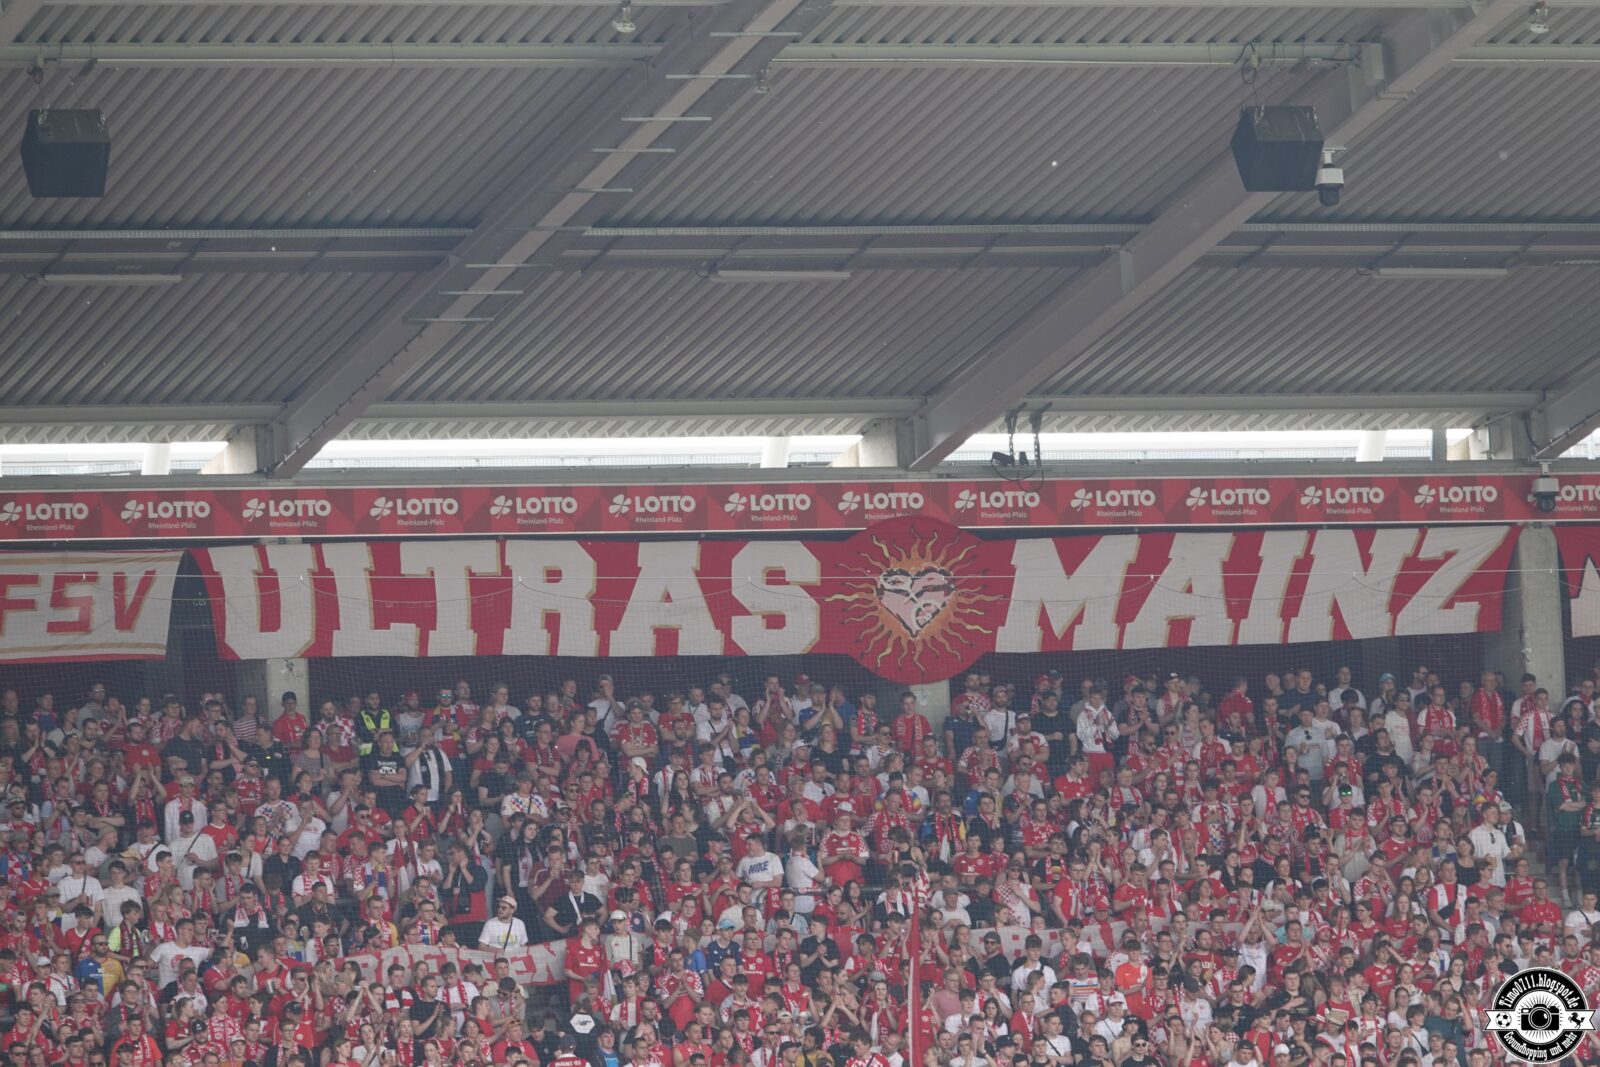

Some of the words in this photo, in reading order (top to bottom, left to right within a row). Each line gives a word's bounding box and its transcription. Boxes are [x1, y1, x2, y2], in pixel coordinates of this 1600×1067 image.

[863, 492, 925, 510] LOTTO
[980, 490, 1041, 508] LOTTO
[1095, 489, 1156, 507] LOTTO
[1211, 488, 1271, 506] LOTTO
[1325, 486, 1385, 505] LOTTO
[1438, 485, 1499, 503] LOTTO
[1555, 484, 1600, 502] OTT
[26, 502, 89, 520] LOTTO
[147, 500, 211, 519] LOTTO
[268, 499, 332, 517] LOTTO
[396, 497, 459, 516] LOTTO
[515, 496, 578, 514] LOTTO
[634, 495, 697, 513] LOTTO
[749, 493, 812, 512] LOTTO
[1438, 506, 1486, 515] Rheinland-Pfalz
[516, 517, 565, 526] Rheinland-Pfalz
[634, 516, 684, 525] Rheinland-Pfalz
[750, 515, 799, 524] Rheinland-Pfalz
[980, 511, 1029, 520] Rheinland-Pfalz
[1096, 510, 1144, 519] Rheinland-Pfalz
[1211, 509, 1259, 518] Rheinland-Pfalz
[1325, 508, 1373, 517] Rheinland-Pfalz
[25, 523, 76, 532] Rheinland-Pfalz
[147, 522, 198, 531] Rheinland-Pfalz
[268, 520, 319, 529] Rheinland-Pfalz
[396, 519, 446, 528] Rheinland-Pfalz
[207, 539, 821, 660] ULTRAS
[995, 525, 1512, 654] MAINZ
[0, 571, 157, 638] FSV
[749, 860, 769, 875] NIKE
